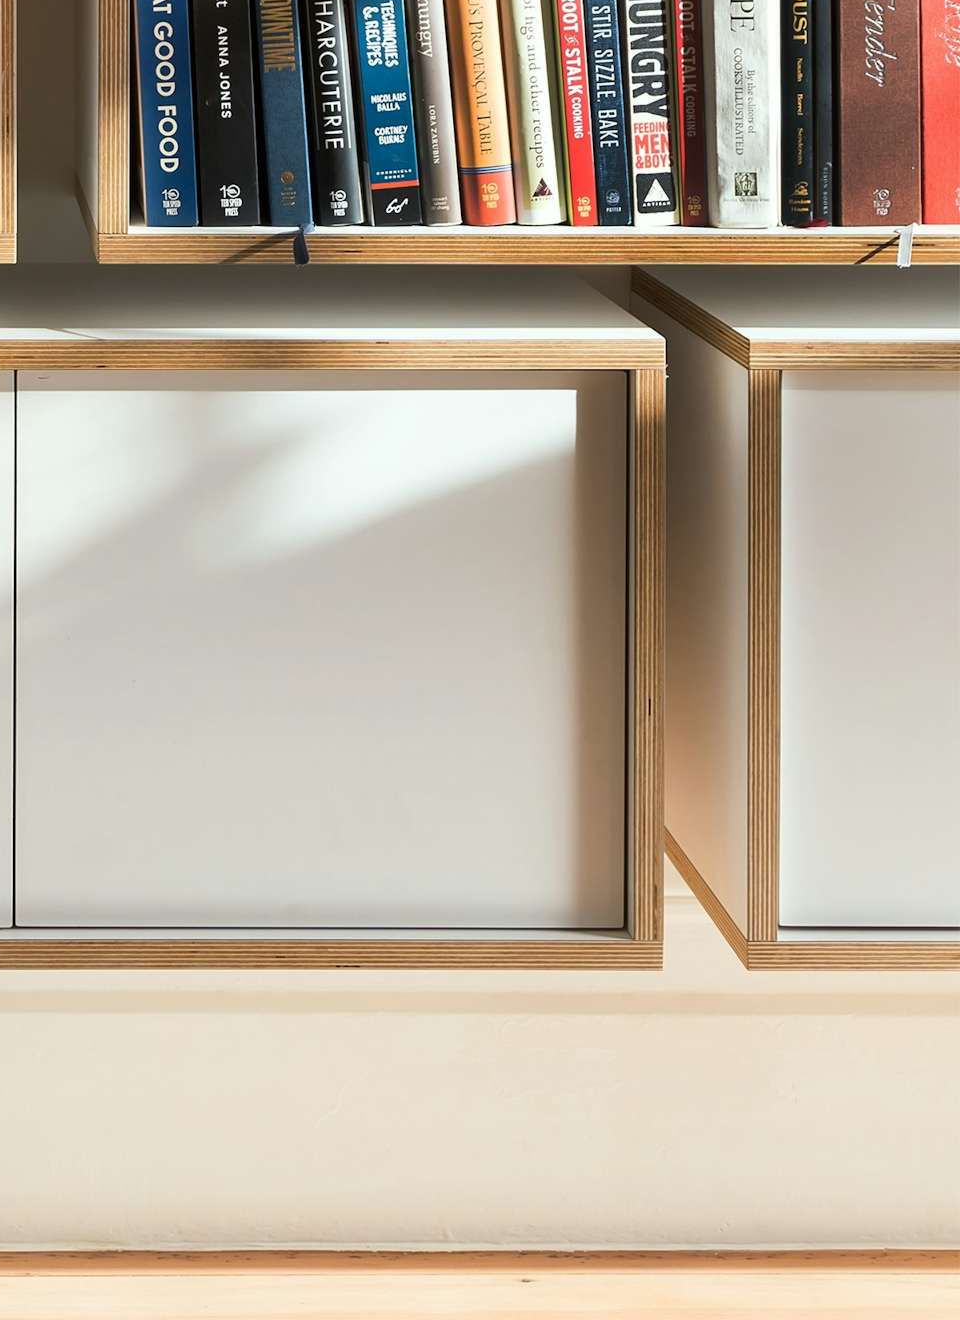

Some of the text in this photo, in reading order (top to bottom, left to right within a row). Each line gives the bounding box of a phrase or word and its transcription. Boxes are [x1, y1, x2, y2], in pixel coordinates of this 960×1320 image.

[380, 0, 399, 68] TECHNIQUES
[520, 16, 536, 40] figs
[526, 44, 539, 71] and
[154, 21, 176, 97] GOOD
[217, 25, 232, 118] ANNA JONES
[468, 21, 486, 108] PROVENÇAL
[477, 110, 492, 156] TABLE
[591, 5, 620, 148] STIR. SIZZLE. BAKE
[530, 75, 544, 113] other
[733, 47, 745, 155] COOK'S ILLUSTRATED
[157, 105, 179, 173] FOOD
[428, 105, 441, 164] LORA ZARUBIN
[529, 118, 546, 169] recipes
[633, 121, 672, 133] FEEDING
[635, 134, 672, 155] MEN
[642, 200, 672, 208] ARTISAN
